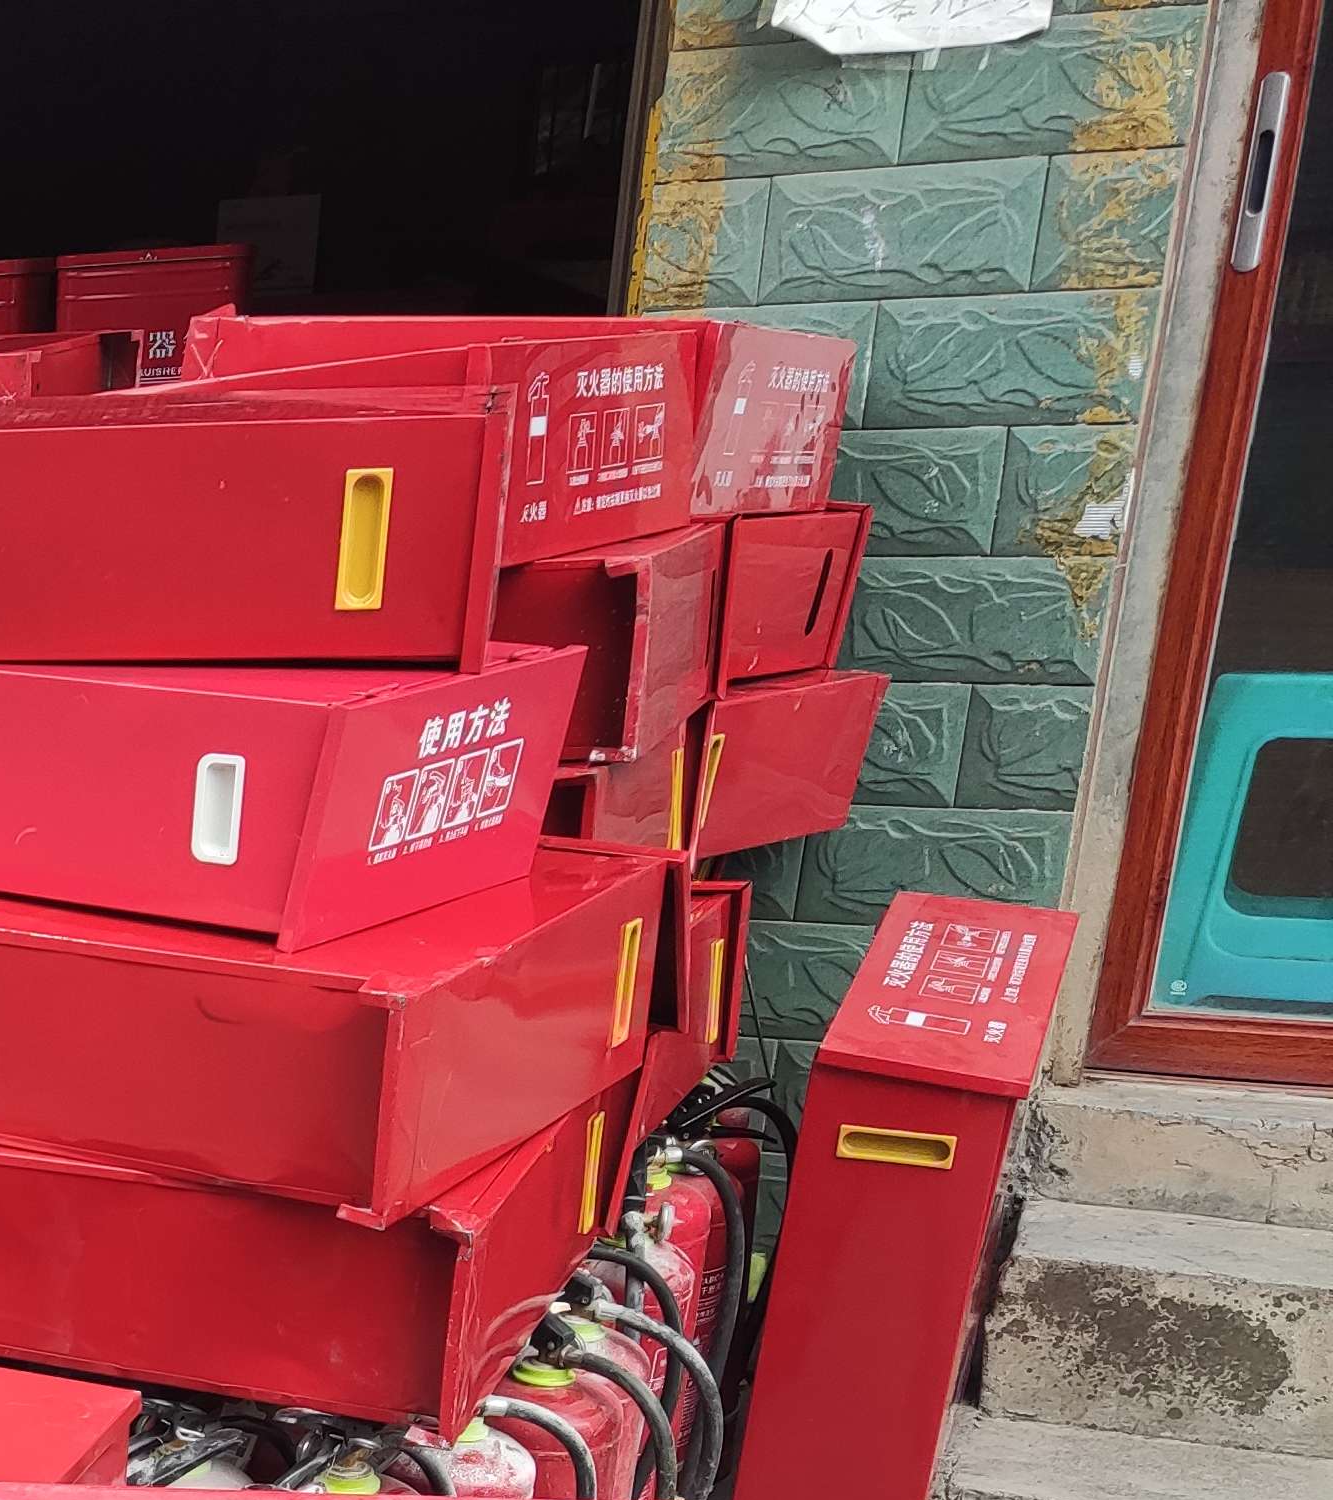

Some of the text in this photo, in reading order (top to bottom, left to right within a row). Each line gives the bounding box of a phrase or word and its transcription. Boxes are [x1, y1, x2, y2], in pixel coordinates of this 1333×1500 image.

[576, 363, 665, 398] 灭火器的使用方法
[418, 697, 512, 759] 使用方法
[883, 920, 934, 989] 灭火器的使用方法
